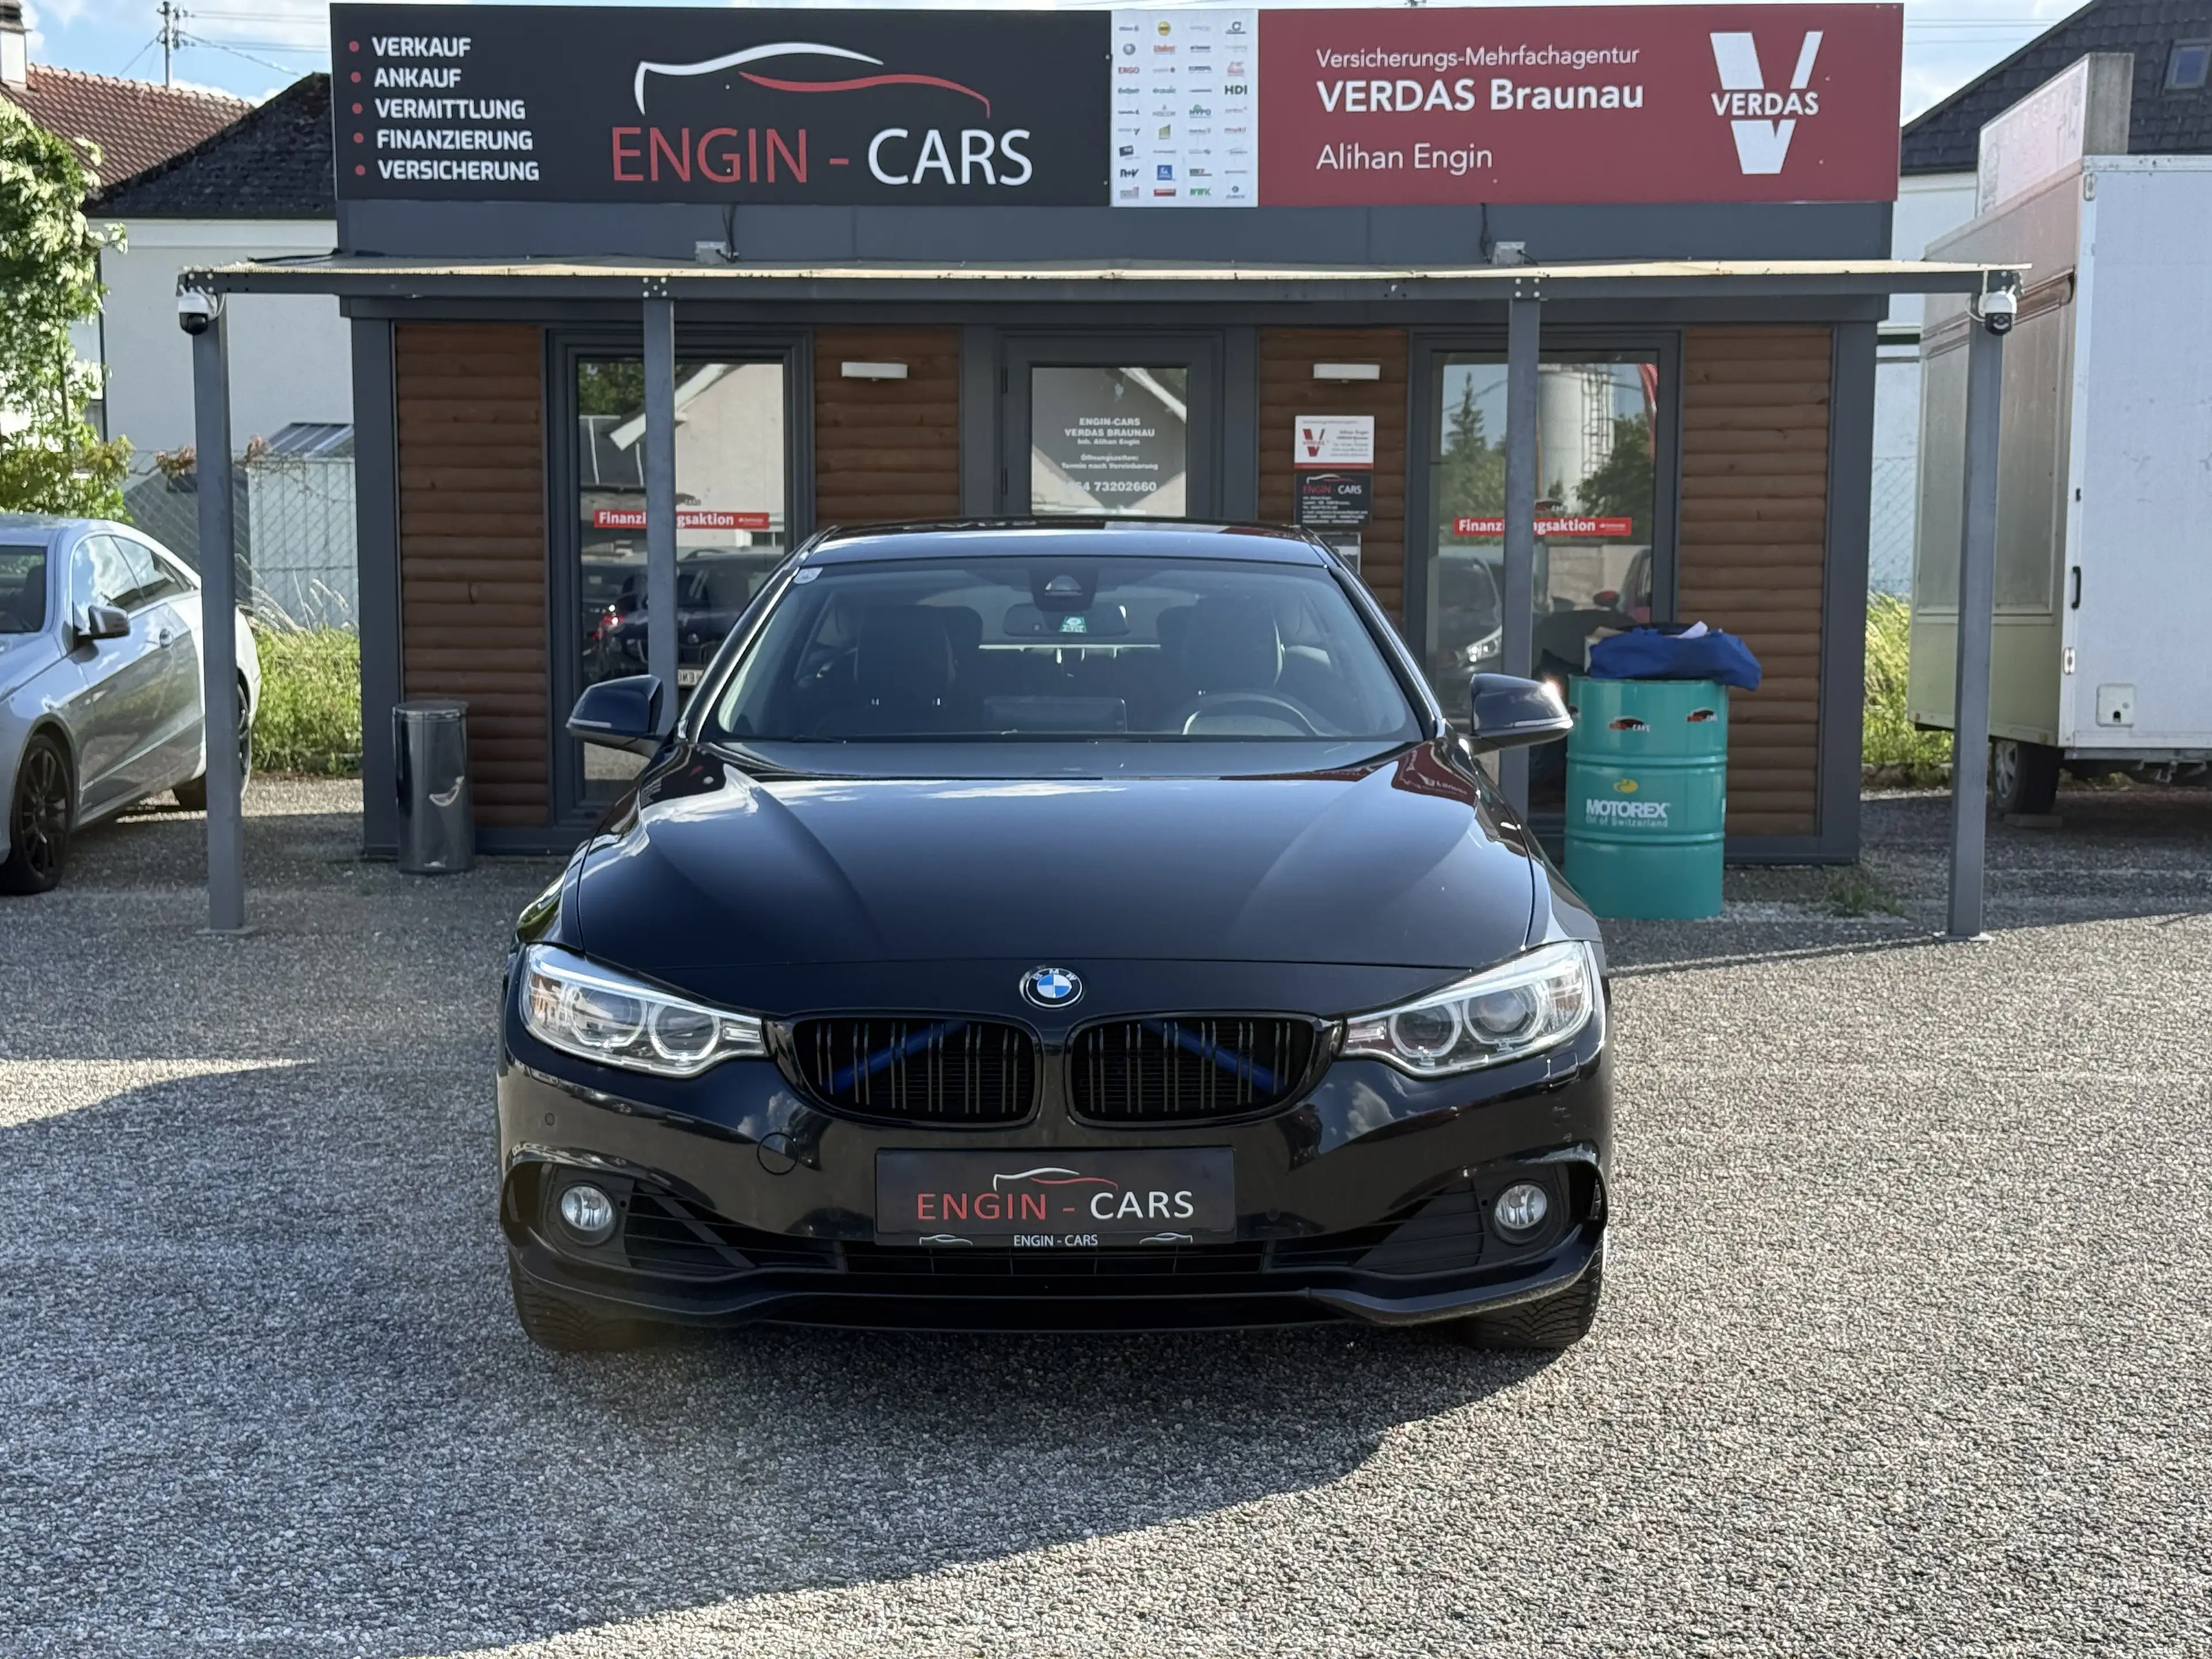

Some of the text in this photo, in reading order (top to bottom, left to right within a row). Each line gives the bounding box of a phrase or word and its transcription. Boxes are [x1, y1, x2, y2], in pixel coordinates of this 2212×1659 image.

[372, 36, 471, 57] VERKAUF
[1316, 44, 1640, 71] Versicherungs-Mehrfachagentur
[374, 67, 461, 88] ANKAUF
[1224, 85, 1248, 95] HDI
[1316, 79, 1643, 112] VERDAS Braunau
[374, 98, 526, 120] VERMITTLUNG
[1710, 90, 1819, 116] VERDAS
[377, 129, 533, 150] FINANZIERUNG
[612, 127, 806, 183] ENGIN
[868, 127, 1033, 186] CARS
[1316, 142, 1493, 175] Alihan Engin
[377, 159, 540, 181] VERSICHERUNG
[1065, 429, 1156, 437] VERDAS BRAUNAU
[1094, 482, 1158, 492] 73202660
[1338, 484, 1362, 495] CARS
[1586, 798, 1671, 819] MOTOREX
[917, 1193, 1046, 1221] ENGIN
[1090, 1191, 1194, 1219] CARS
[1013, 1234, 1054, 1247] ENGIN
[1064, 1234, 1099, 1247] CARS
